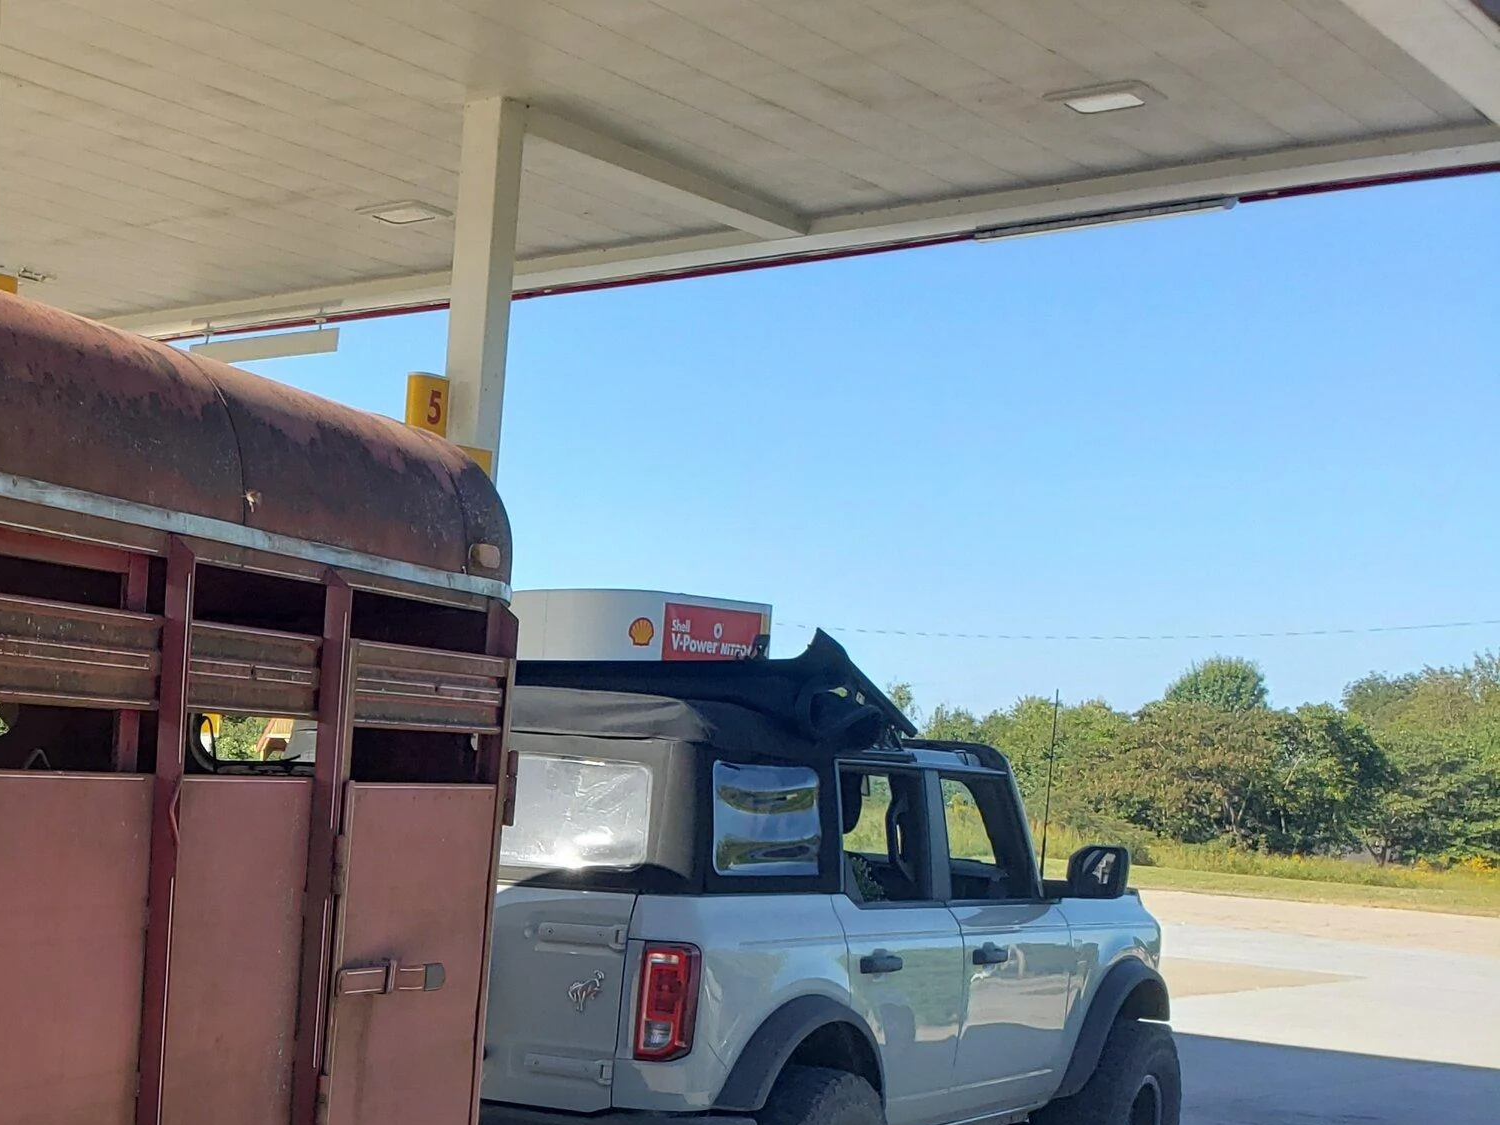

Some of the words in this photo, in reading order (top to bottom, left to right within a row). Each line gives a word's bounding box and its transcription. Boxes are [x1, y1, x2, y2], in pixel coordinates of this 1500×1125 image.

[427, 389, 442, 425] 5
[671, 619, 691, 633] Shell
[671, 633, 717, 655] V-Power
